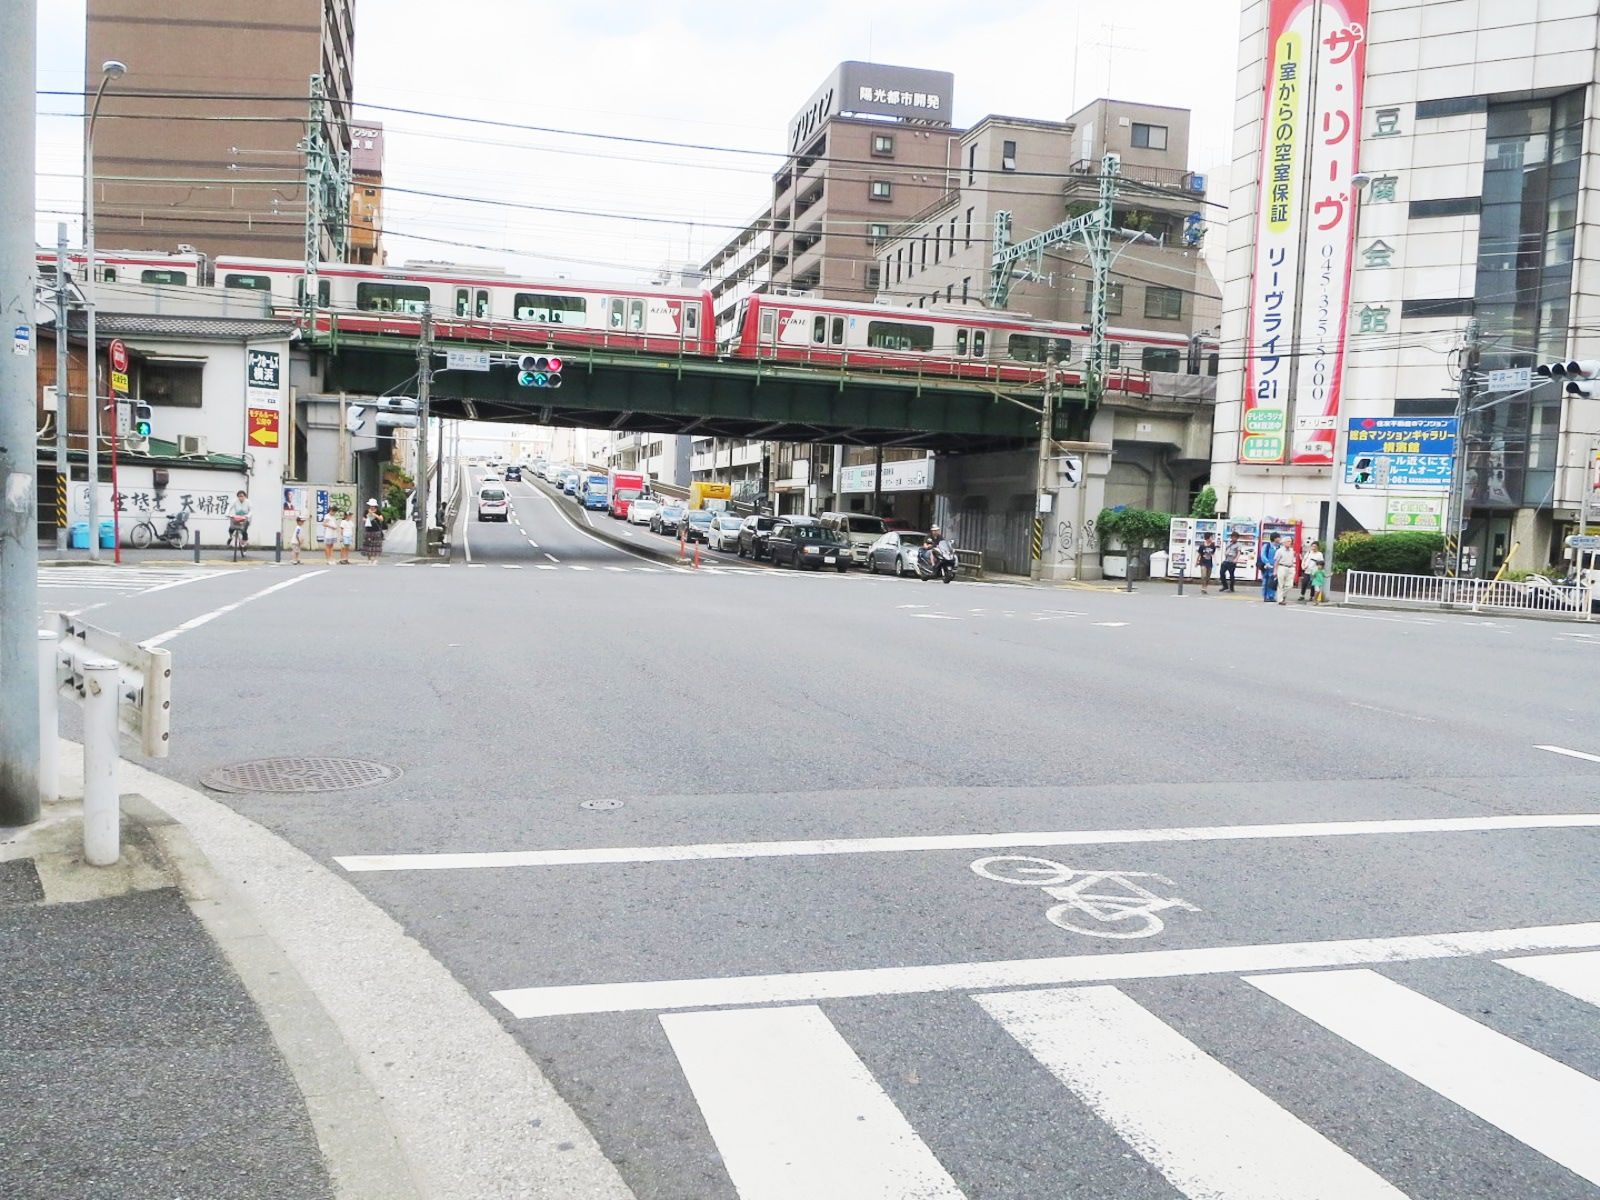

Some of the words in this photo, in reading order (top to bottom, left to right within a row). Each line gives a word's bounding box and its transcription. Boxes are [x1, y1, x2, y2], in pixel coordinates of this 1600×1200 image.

[859, 86, 940, 110] 陽光都市開発
[1271, 42, 1297, 223] 1室からの空室保証
[1314, 24, 1361, 230] ザ・リーヴ
[1358, 107, 1401, 333] 豆腐会館
[1257, 247, 1285, 399] リーヴライフ21
[1311, 244, 1333, 401] 045-325-5600
